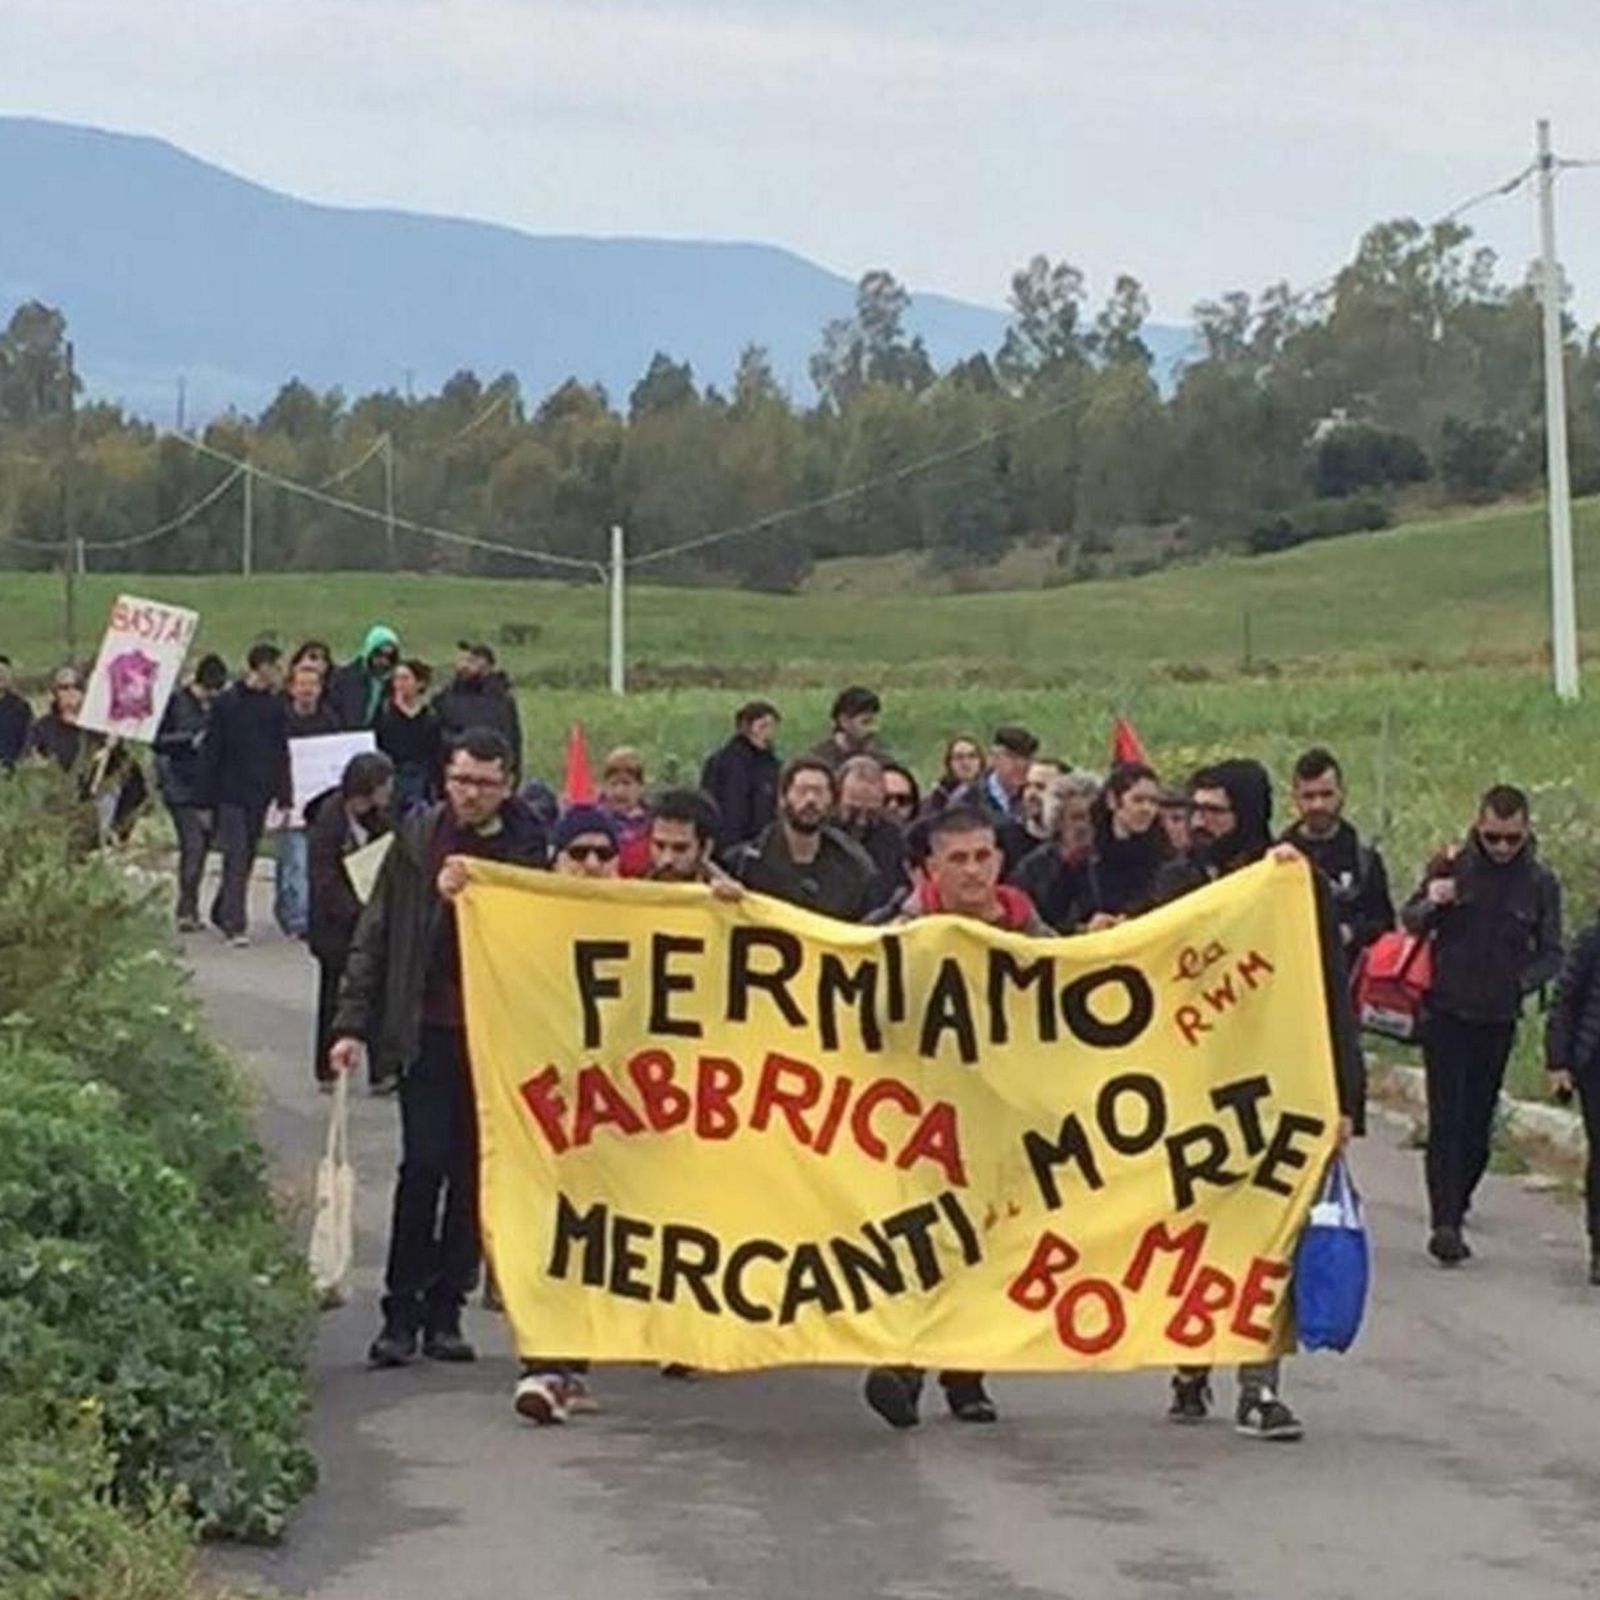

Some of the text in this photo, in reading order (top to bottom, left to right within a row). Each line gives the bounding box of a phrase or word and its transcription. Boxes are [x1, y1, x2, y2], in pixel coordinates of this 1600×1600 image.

[572, 925, 1154, 1064] FERMIAMO
[1175, 949, 1275, 1047] RWM
[519, 1049, 968, 1188] FABBRICA
[1022, 1073, 1326, 1212] MORTE
[547, 1190, 1290, 1355] MERCANTI BOMBE
